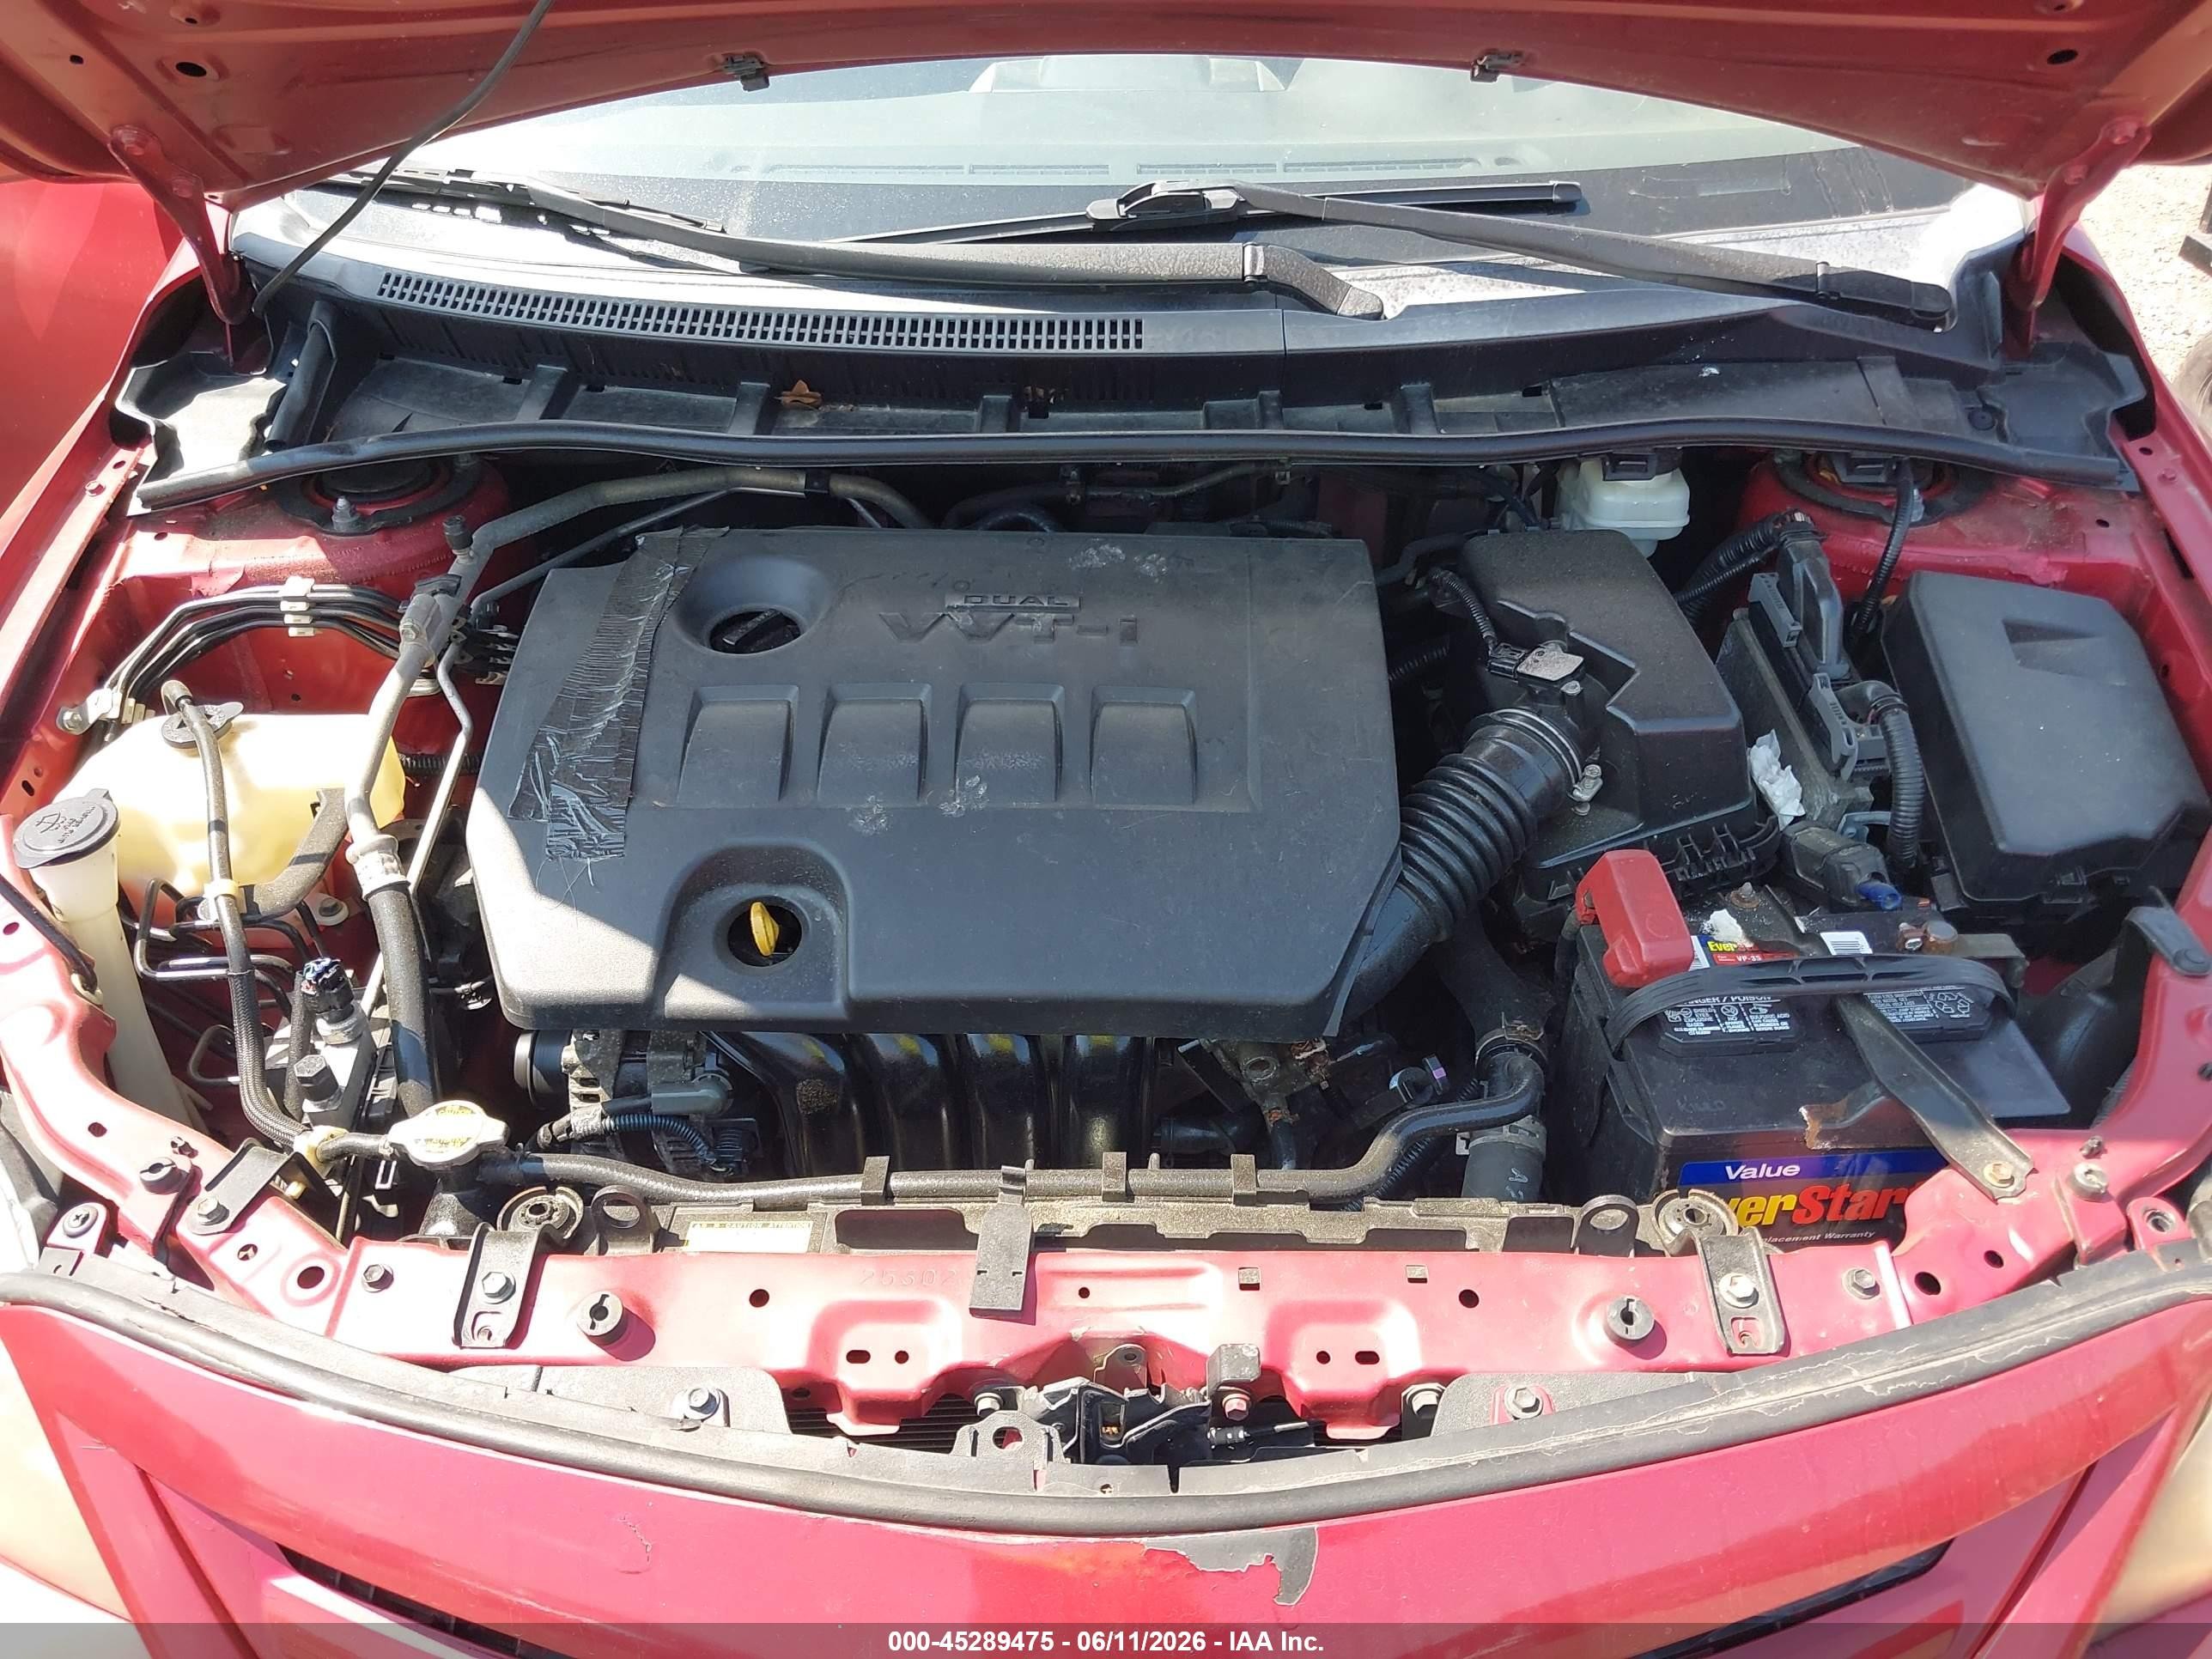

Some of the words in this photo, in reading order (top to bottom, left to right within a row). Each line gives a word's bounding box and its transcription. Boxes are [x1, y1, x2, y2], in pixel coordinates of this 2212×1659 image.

[963, 594, 1069, 605] DUAL
[1725, 1162, 1801, 1181] Value
[1824, 1231, 1876, 1240] Warranty
